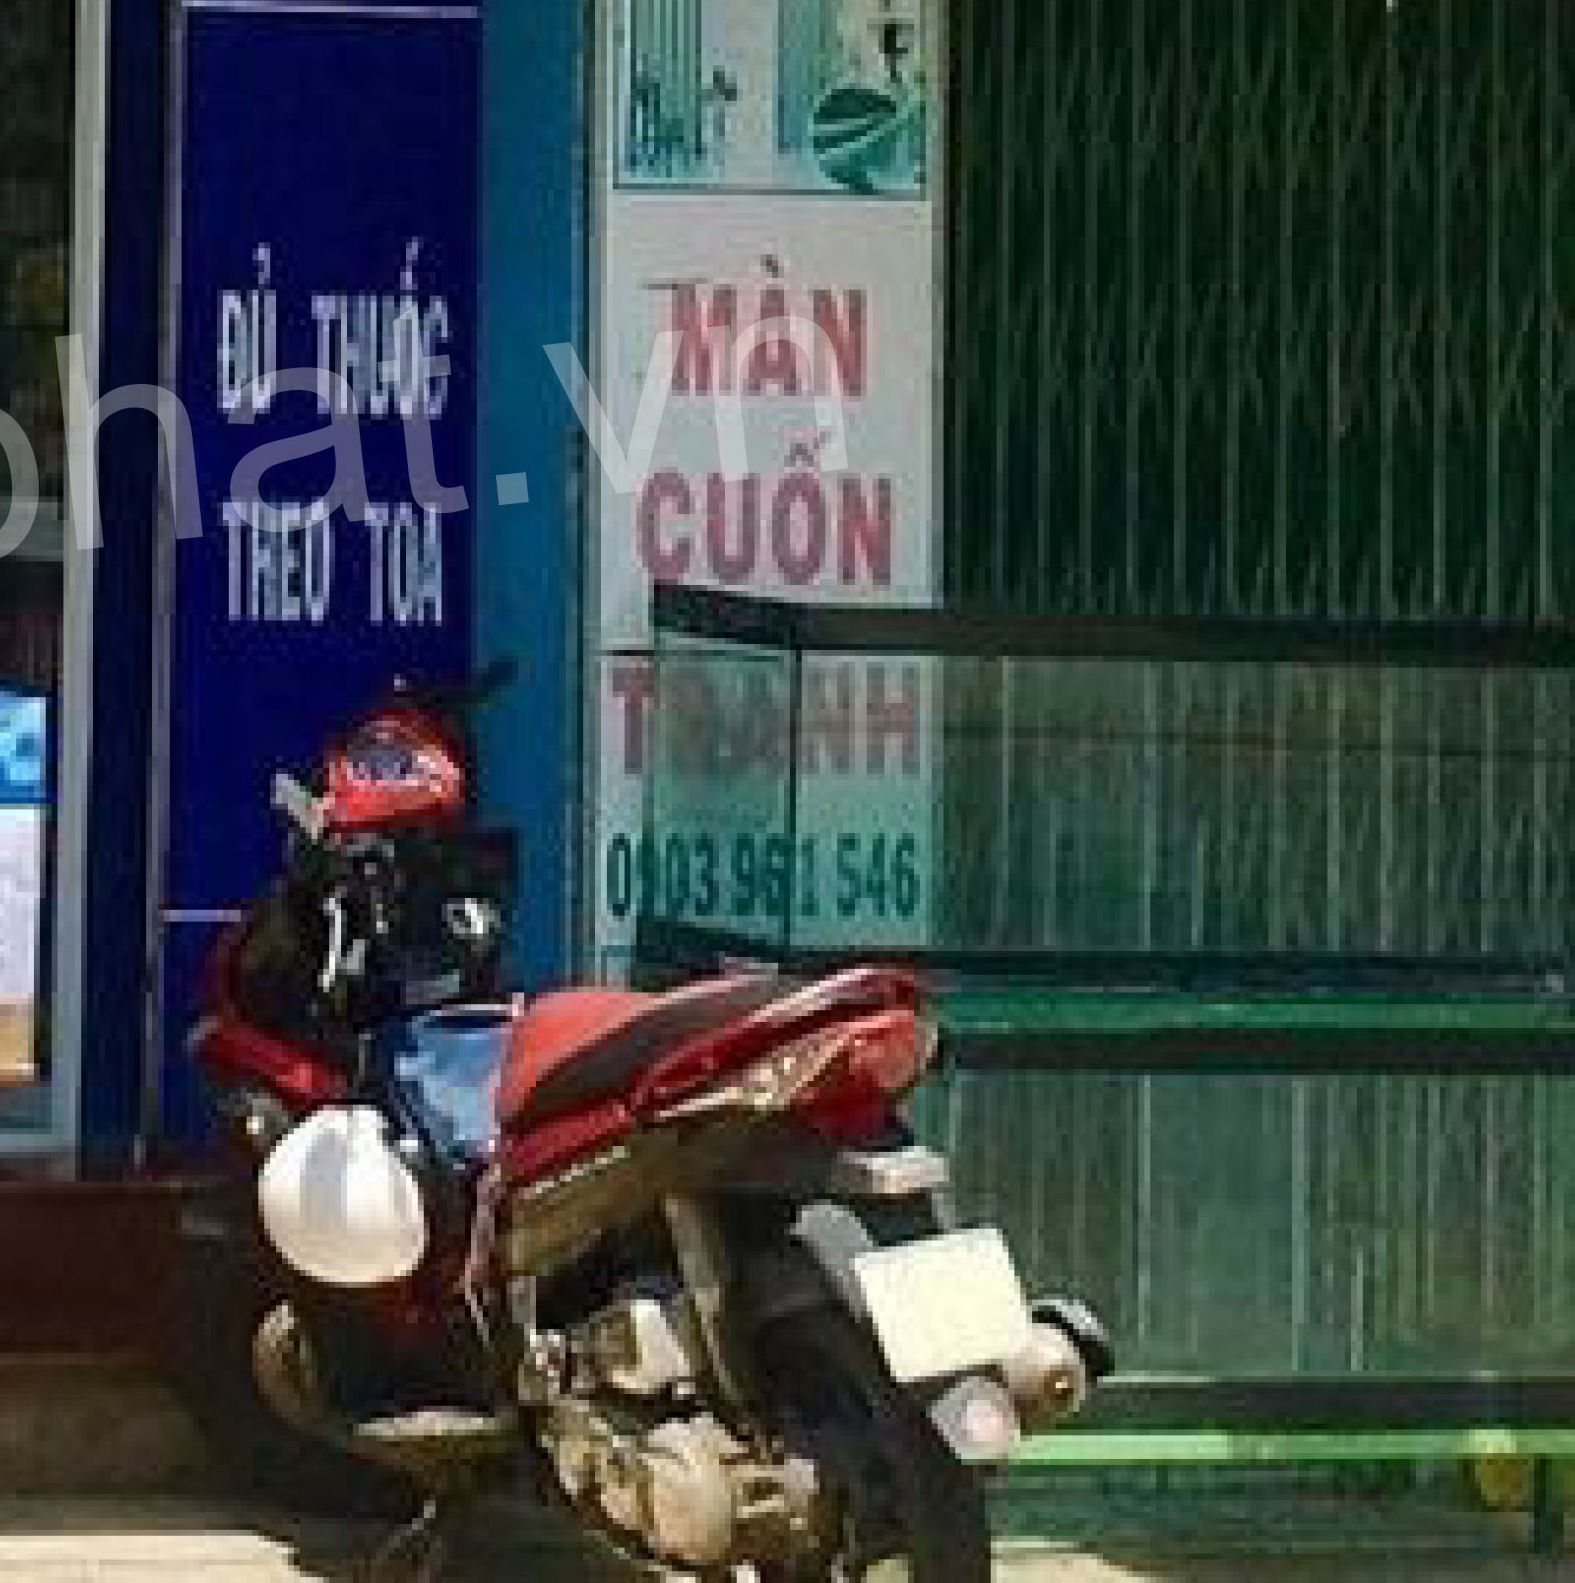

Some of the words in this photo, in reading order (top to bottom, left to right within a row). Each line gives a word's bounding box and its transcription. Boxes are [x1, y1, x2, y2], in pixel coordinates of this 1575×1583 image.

[668, 253, 868, 397] MÀN
[637, 430, 895, 588] CUỐN
[835, 832, 921, 919] 546
